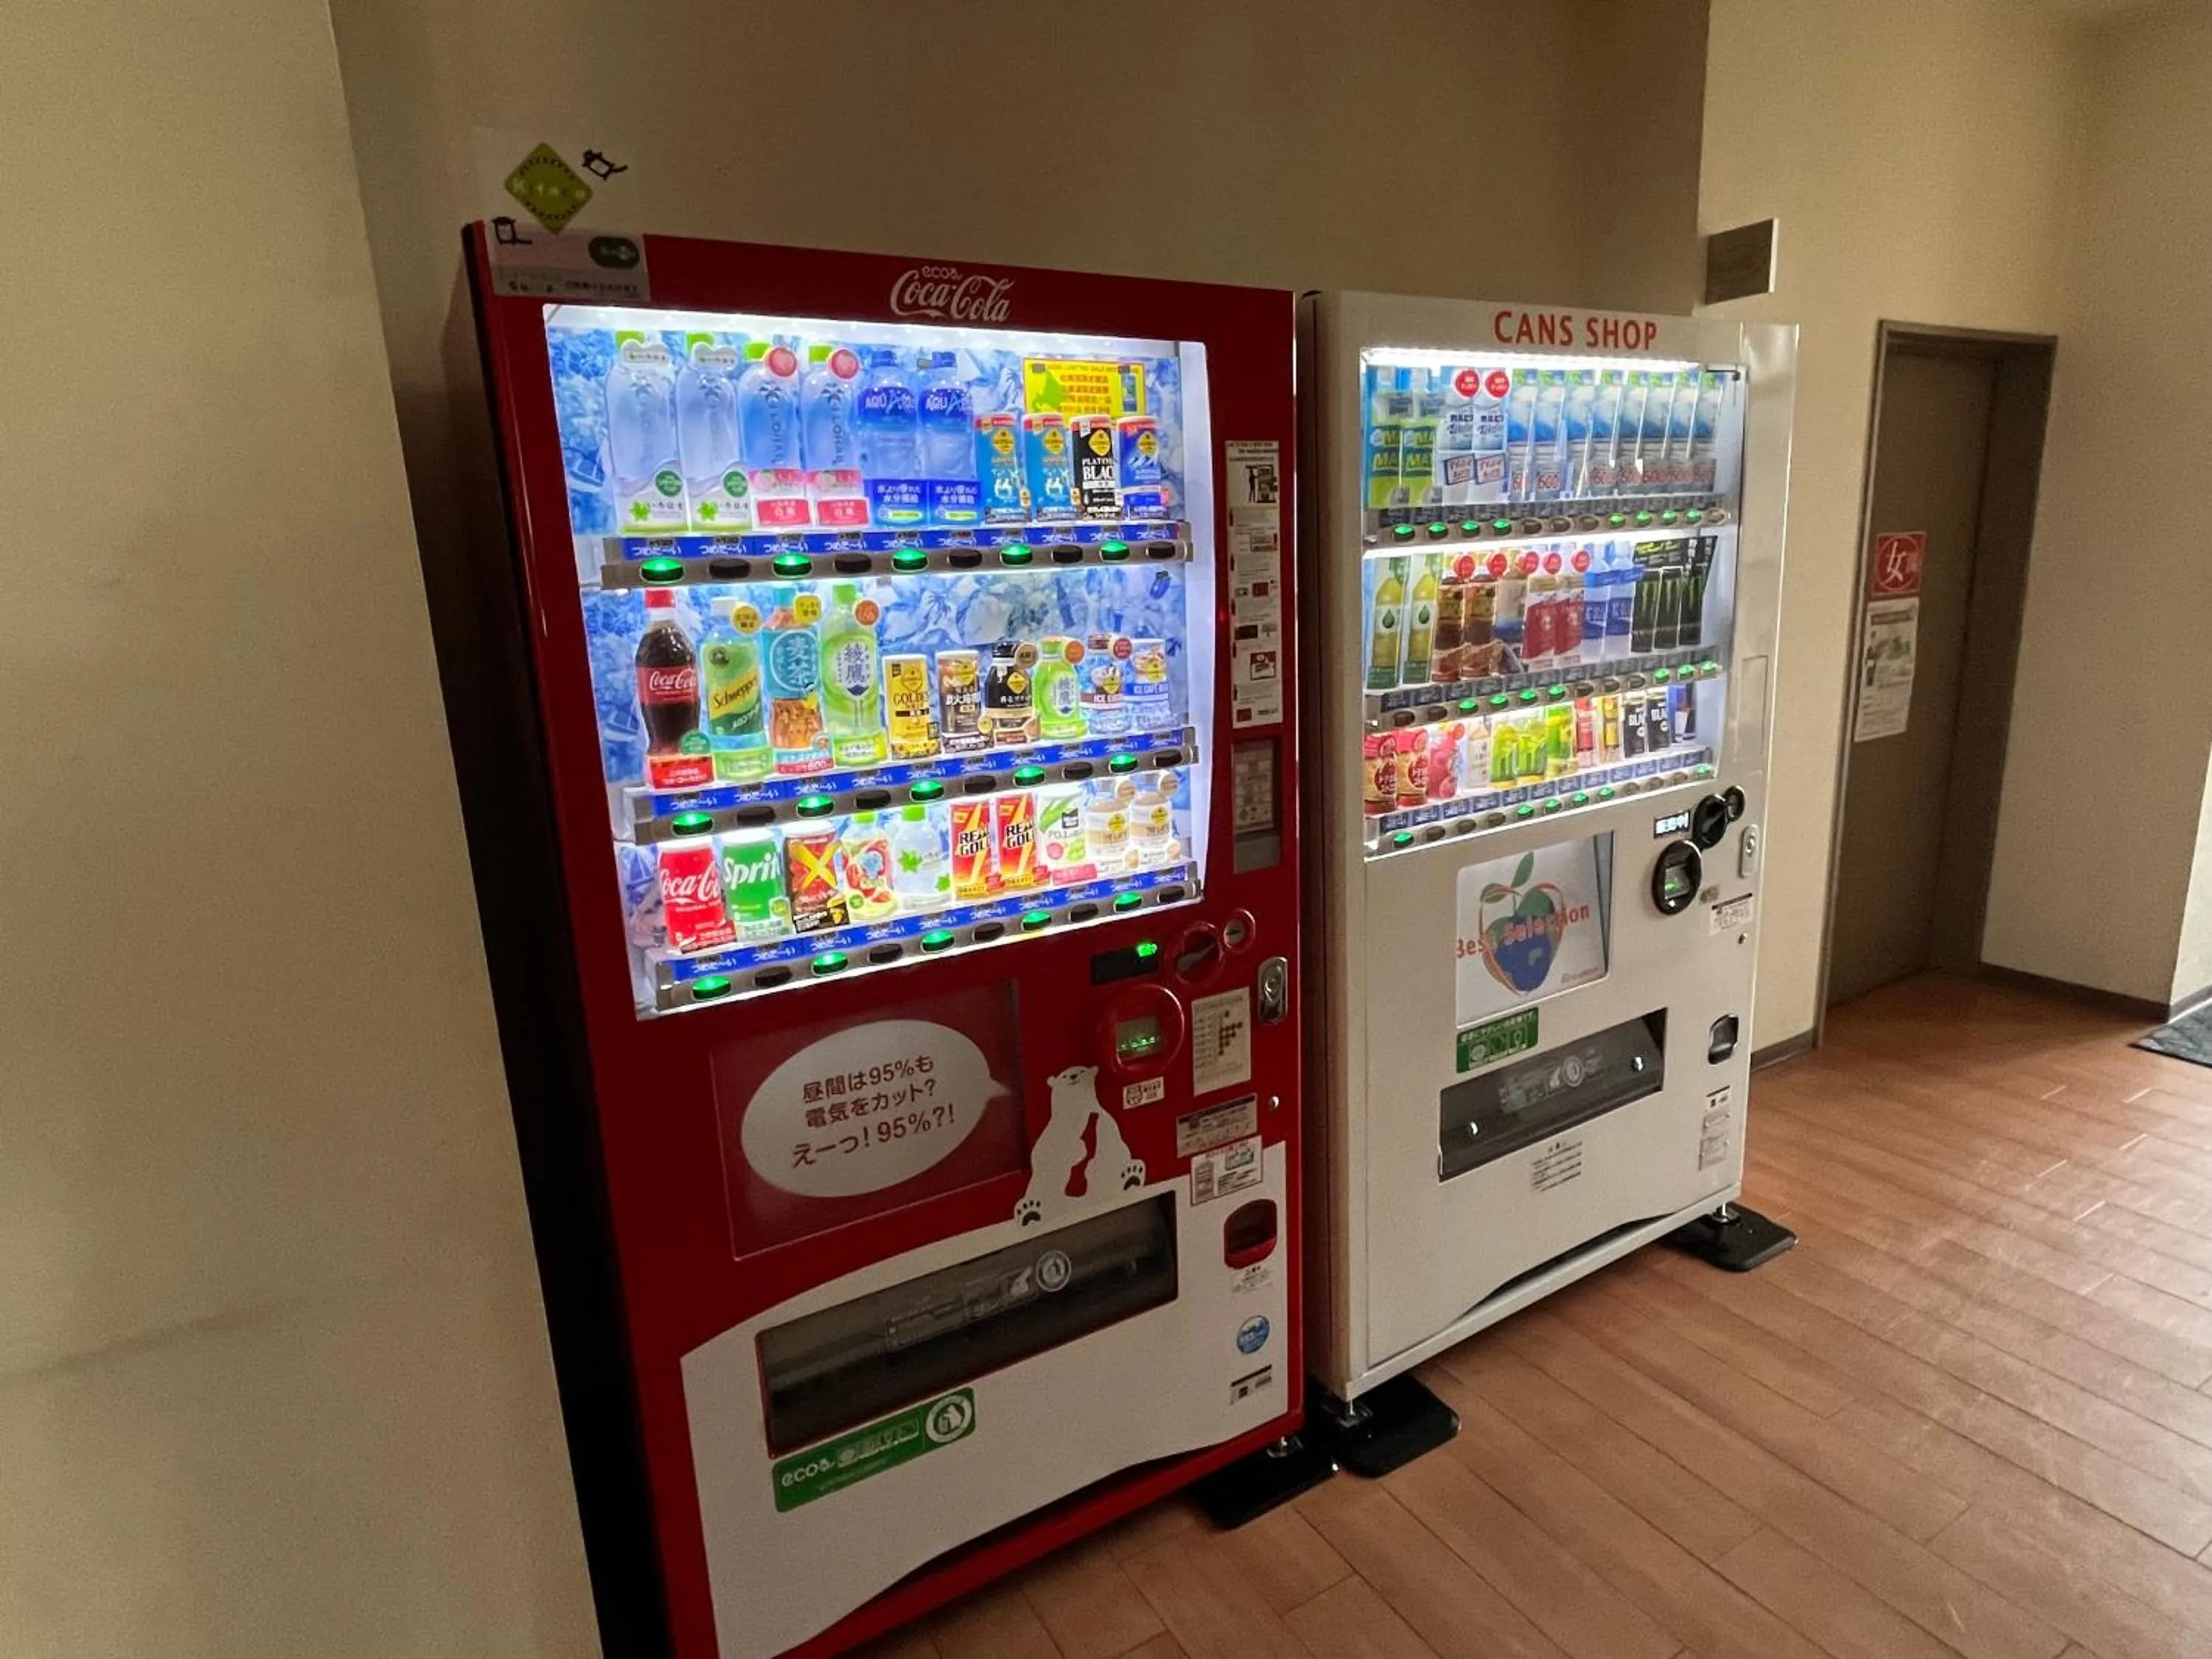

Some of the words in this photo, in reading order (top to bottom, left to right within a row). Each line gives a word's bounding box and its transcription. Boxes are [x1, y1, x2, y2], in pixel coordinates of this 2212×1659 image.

[890, 269, 1015, 322] Coca-Cola
[1494, 310, 1573, 347] CANS
[1586, 316, 1658, 349] SHOP
[1882, 540, 1907, 583] 女
[802, 1054, 934, 1103] 昼間は95%も
[805, 1079, 936, 1129] 電気をカット?
